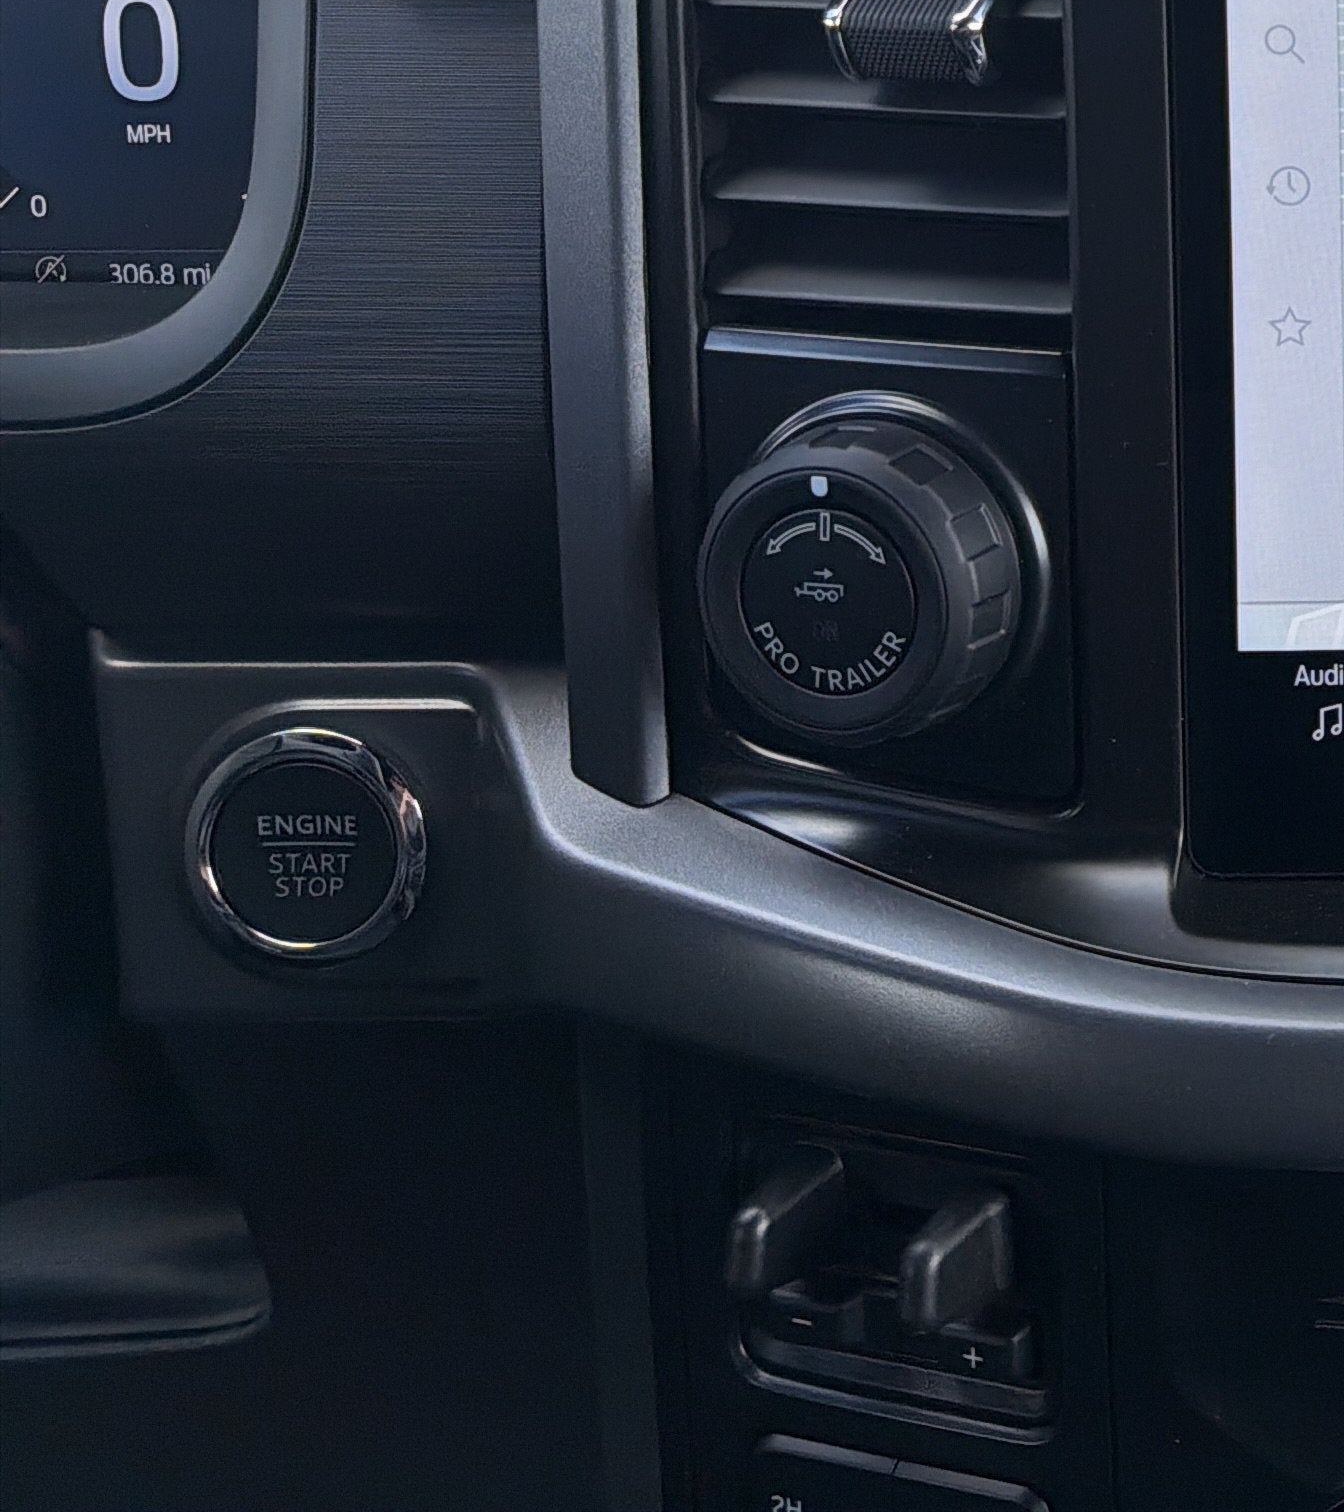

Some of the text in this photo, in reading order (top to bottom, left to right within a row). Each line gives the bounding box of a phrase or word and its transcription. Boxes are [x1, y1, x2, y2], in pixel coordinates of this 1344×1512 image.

[126, 124, 172, 144] MPH
[30, 194, 47, 218] 0
[109, 261, 212, 286] 306.8 mi
[753, 622, 907, 691] PRO TRAILER
[256, 814, 359, 837] ENGINE
[268, 852, 352, 876] START
[275, 877, 345, 899] STOP
